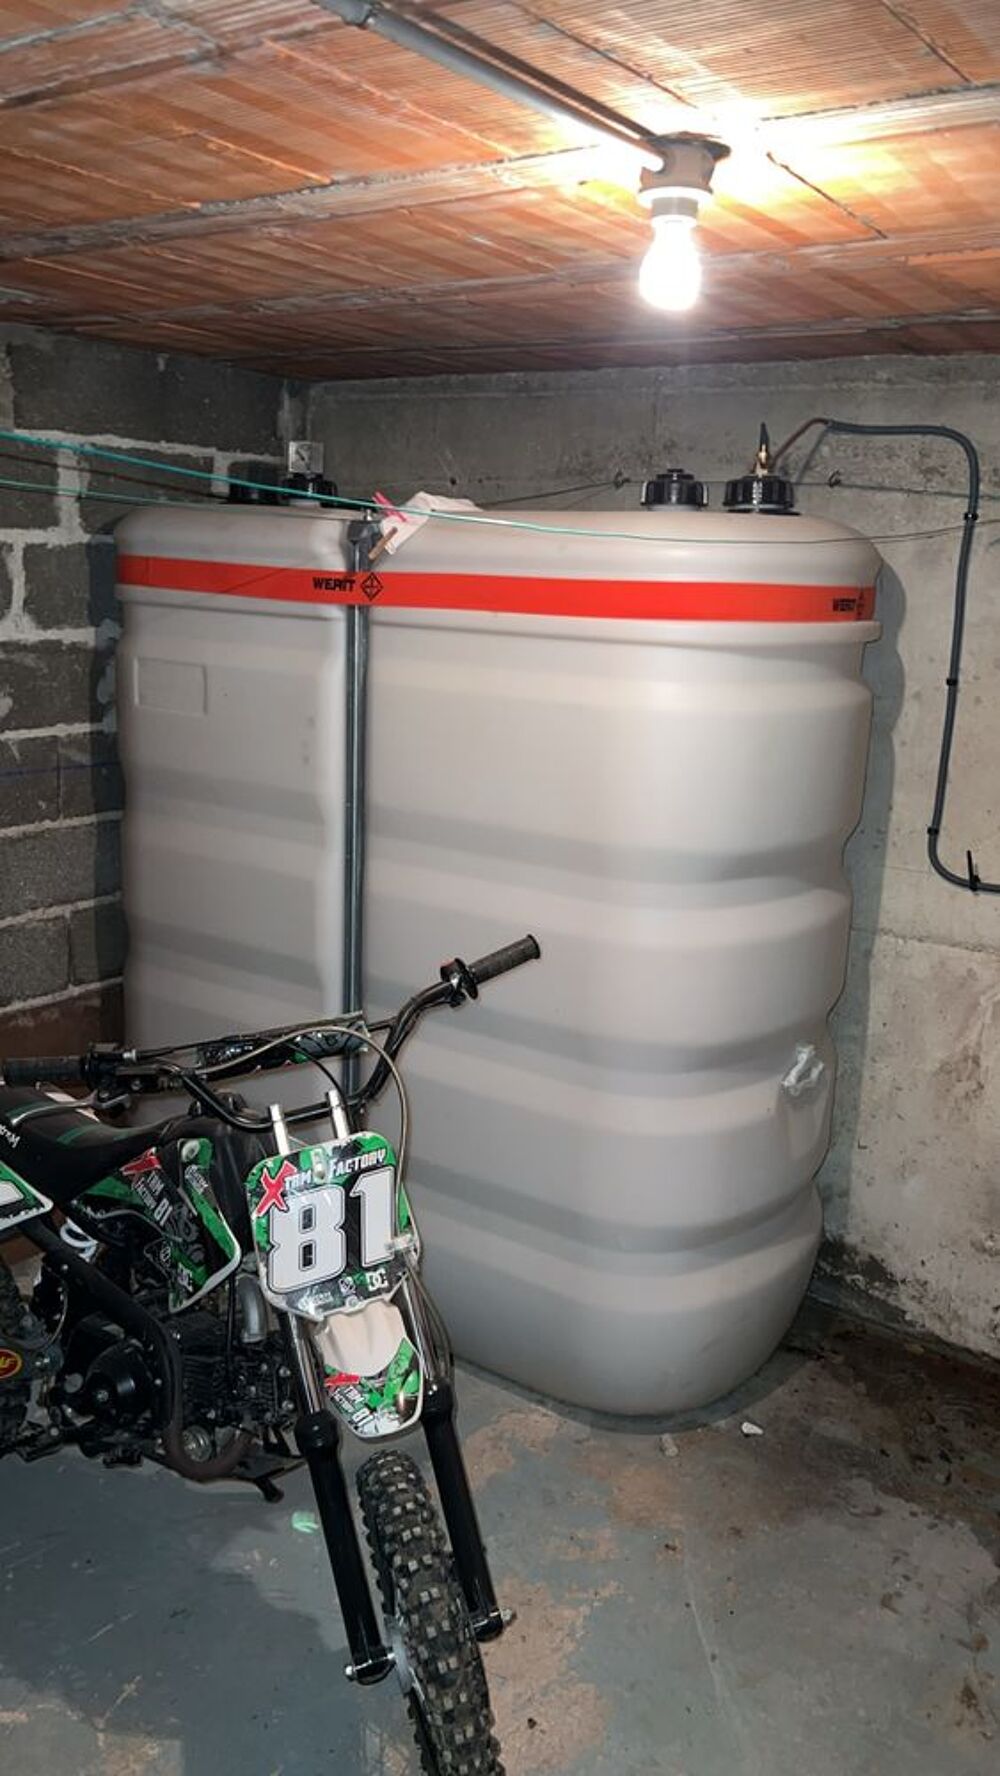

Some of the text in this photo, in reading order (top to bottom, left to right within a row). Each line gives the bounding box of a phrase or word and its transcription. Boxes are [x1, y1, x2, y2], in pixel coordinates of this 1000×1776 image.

[312, 576, 356, 592] WERIT
[329, 1149, 387, 1176] FACTORY
[153, 1197, 174, 1227] 81
[268, 1166, 397, 1295] 81
[366, 1267, 389, 1292] DC
